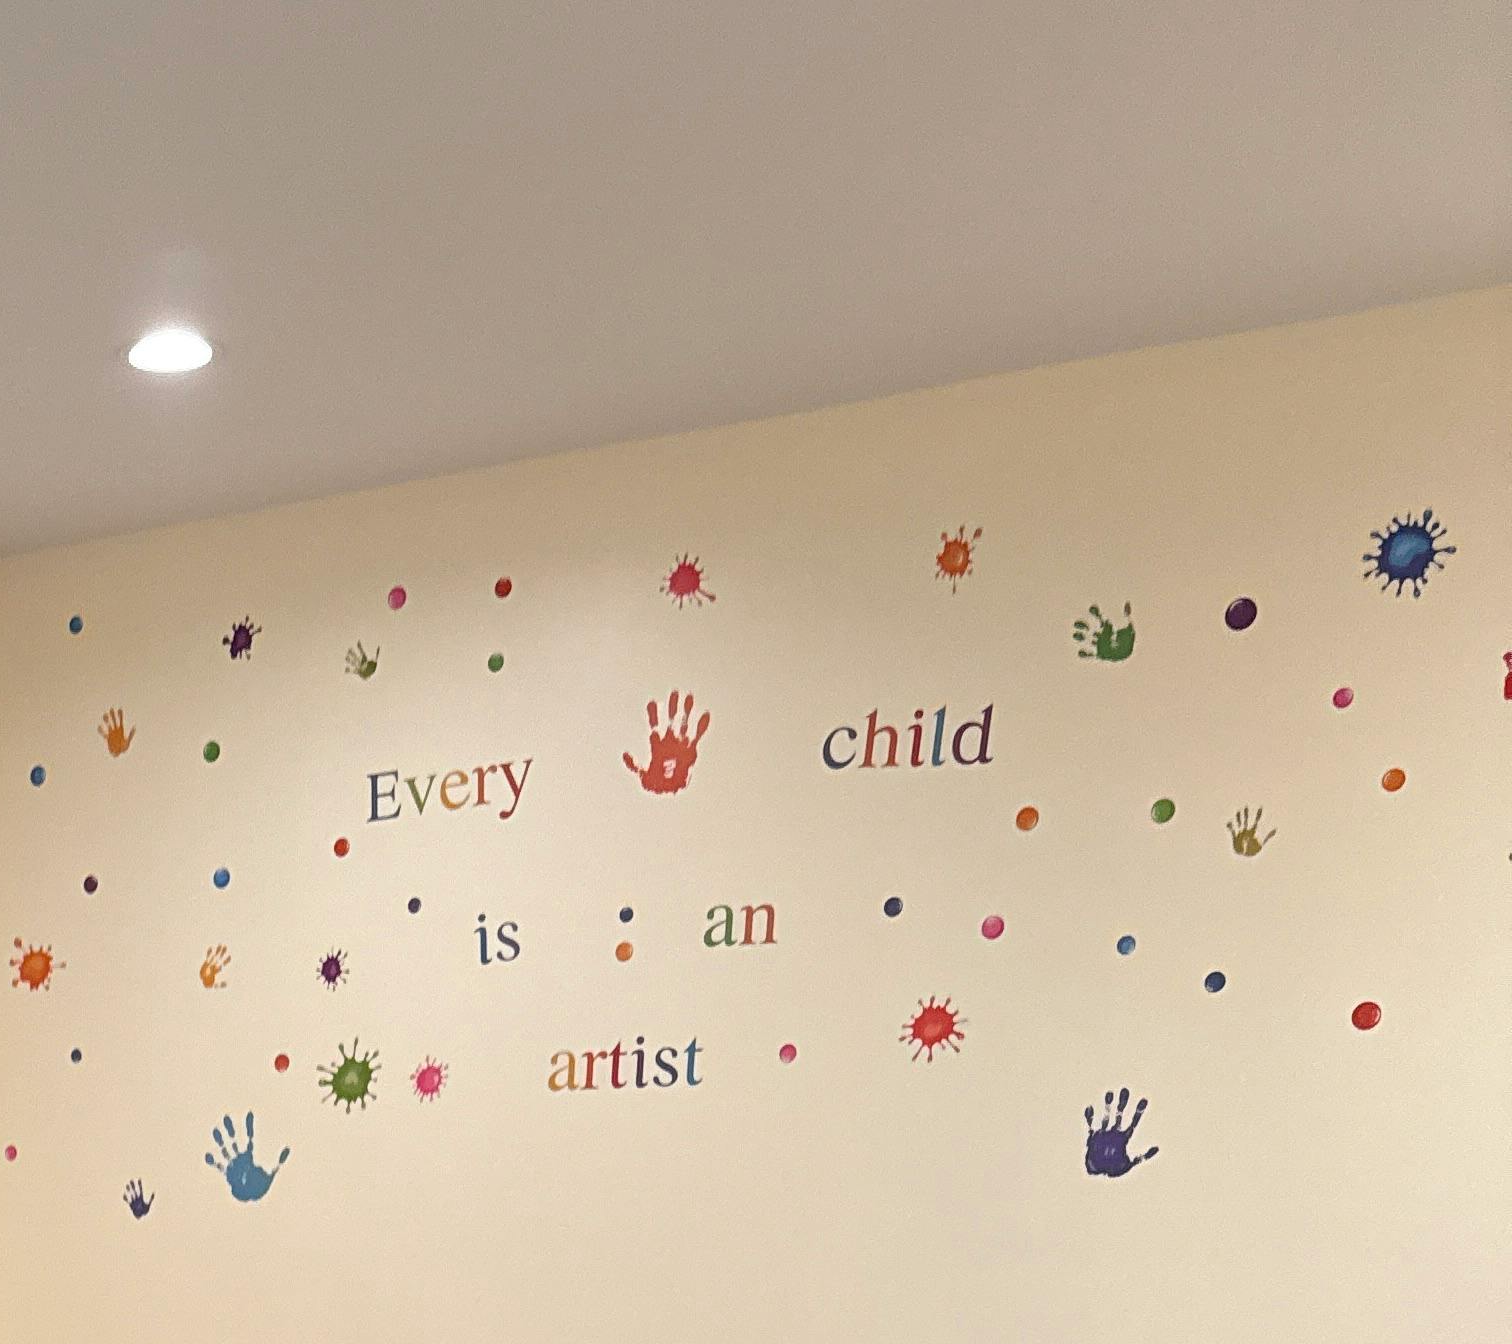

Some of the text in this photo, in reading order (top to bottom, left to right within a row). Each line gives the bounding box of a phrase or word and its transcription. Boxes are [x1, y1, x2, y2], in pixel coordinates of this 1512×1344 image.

[366, 703, 994, 823] Every child
[475, 902, 776, 965] is an
[548, 1035, 703, 1091] artist
